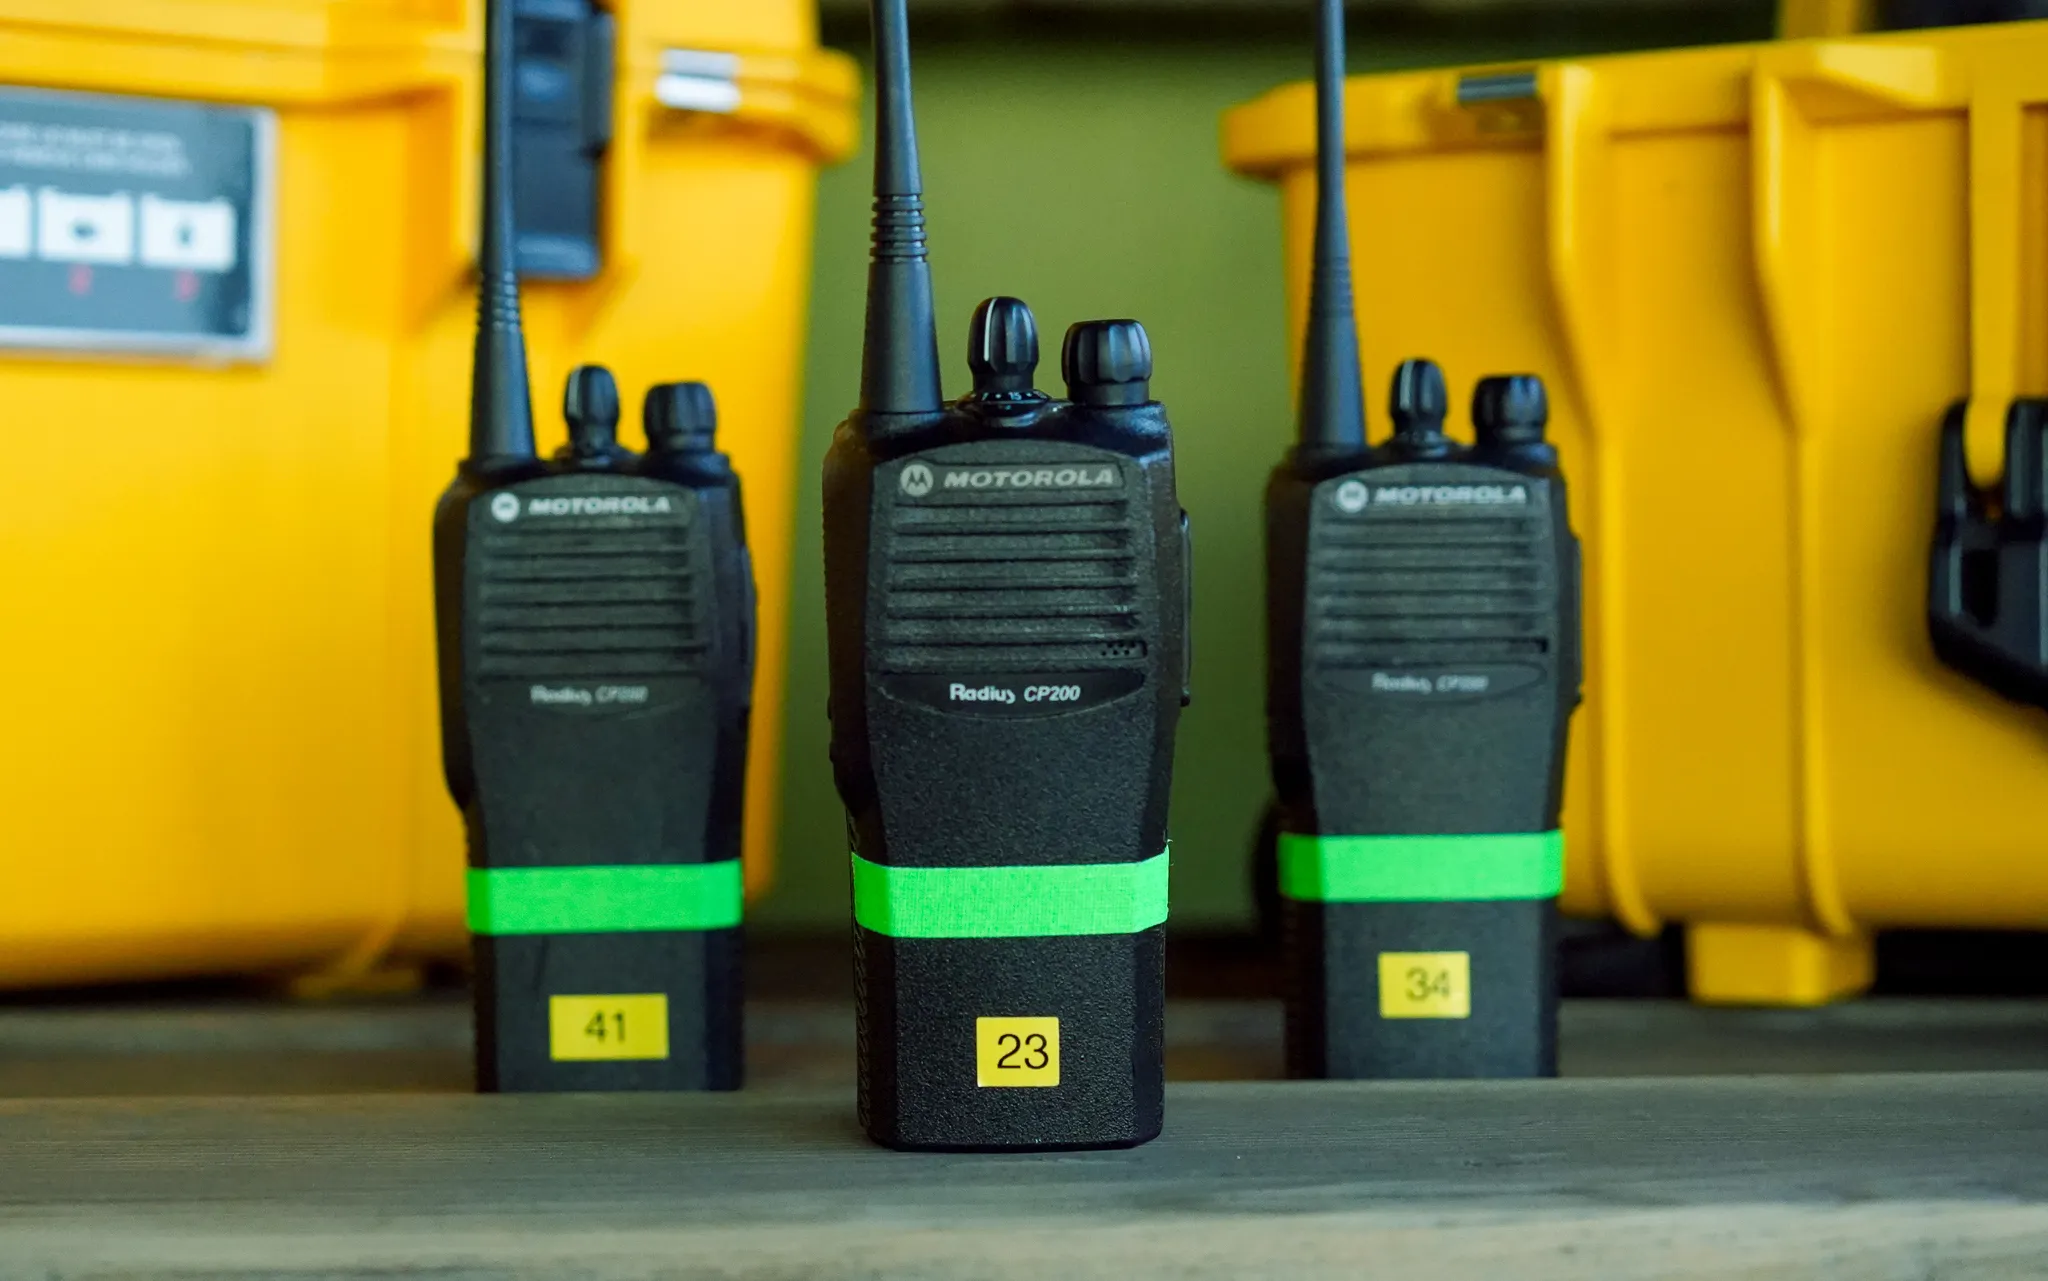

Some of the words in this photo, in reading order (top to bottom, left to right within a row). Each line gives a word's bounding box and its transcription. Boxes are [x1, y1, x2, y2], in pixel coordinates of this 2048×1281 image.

[944, 468, 1114, 488] MOTOROLA
[949, 682, 1016, 705] Radius
[1023, 685, 1081, 703] CP200
[1405, 966, 1450, 1002] 34
[584, 1009, 626, 1044] 41
[997, 1033, 1049, 1070] 23
